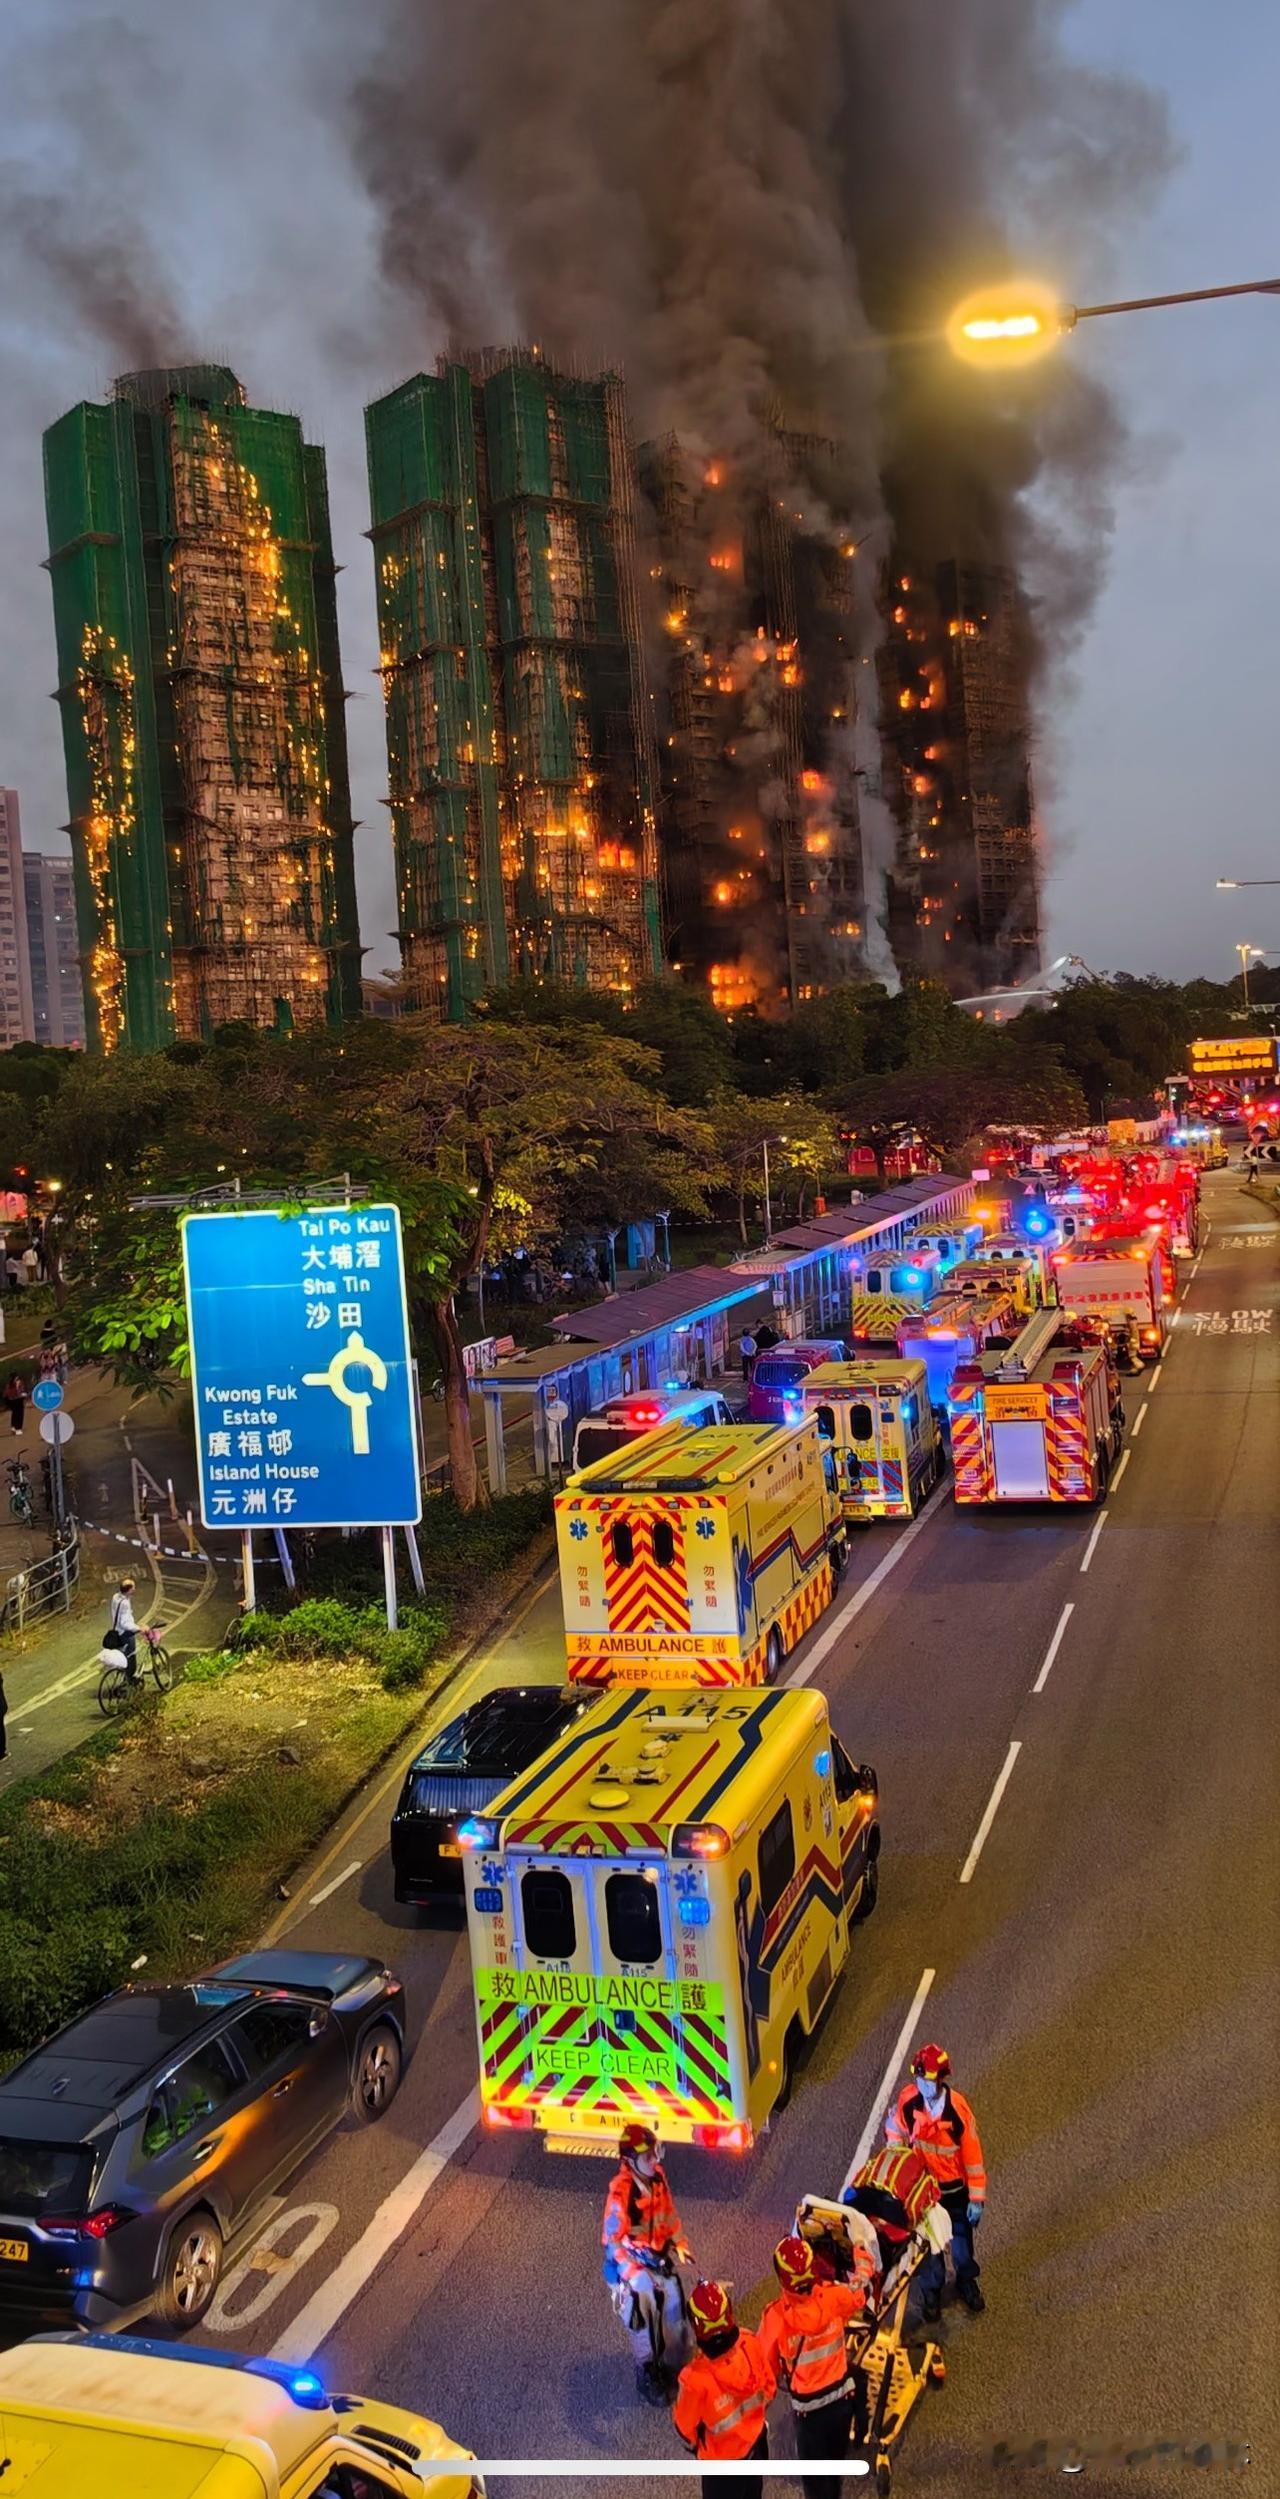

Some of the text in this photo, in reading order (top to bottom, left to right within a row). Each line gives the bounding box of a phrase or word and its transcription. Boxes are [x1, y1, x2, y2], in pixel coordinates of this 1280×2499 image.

[299, 1216, 391, 1236] Tai Po Kau
[303, 1275, 371, 1295] Sha Tin
[305, 1302, 362, 1329] 沙田
[1194, 1309, 1273, 1320] SLOW
[205, 1385, 297, 1405] Kwong Fuk
[223, 1409, 277, 1425] Estate
[208, 1429, 293, 1457] 廣福邨
[210, 1464, 320, 1481] Island House
[211, 1487, 297, 1515] 元洲仔
[599, 1638, 705, 1653] AMBULANCE
[618, 1669, 689, 1681] KEEP CLEAR
[632, 1705, 752, 1720] A115
[492, 1971, 707, 2011] 救 AMBULANCE 護
[535, 2047, 670, 2077] KEEP CLEAR
[0, 2243, 26, 2257] 247
